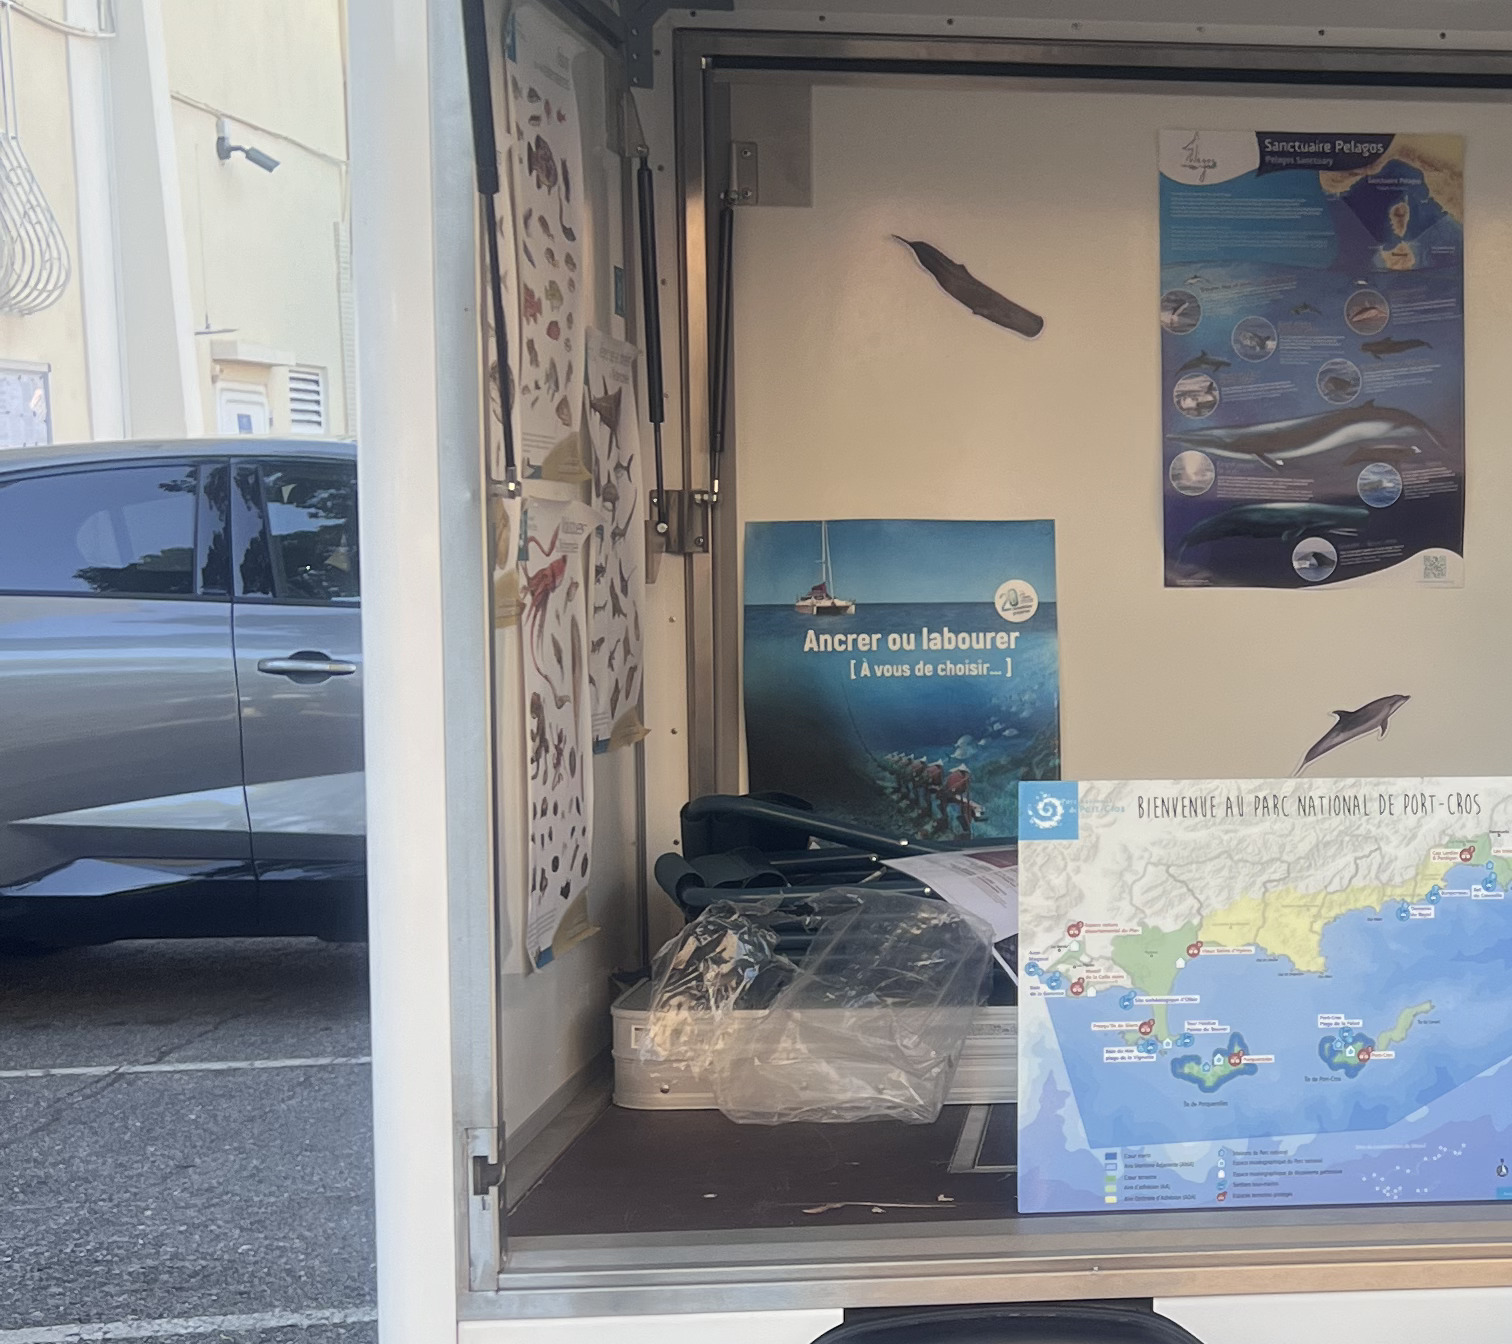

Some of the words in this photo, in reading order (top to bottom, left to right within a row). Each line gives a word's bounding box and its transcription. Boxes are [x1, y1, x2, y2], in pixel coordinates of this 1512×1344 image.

[1264, 139, 1331, 153] Sanctuaire
[1335, 140, 1384, 157] Pelagos
[1296, 157, 1334, 167] Sanctuary
[803, 629, 882, 652] Ancrer
[887, 632, 915, 652] ou
[921, 627, 1020, 651] labourer
[860, 658, 871, 678] À
[874, 660, 910, 677] vous
[914, 658, 933, 677] de
[1138, 795, 1217, 819] BIENVENUE
[1225, 795, 1244, 818] AU
[1254, 794, 1290, 818] PARC
[1298, 793, 1370, 817] NATIONAL
[1378, 793, 1395, 816] DE
[1403, 791, 1482, 816] PORT-CROS
